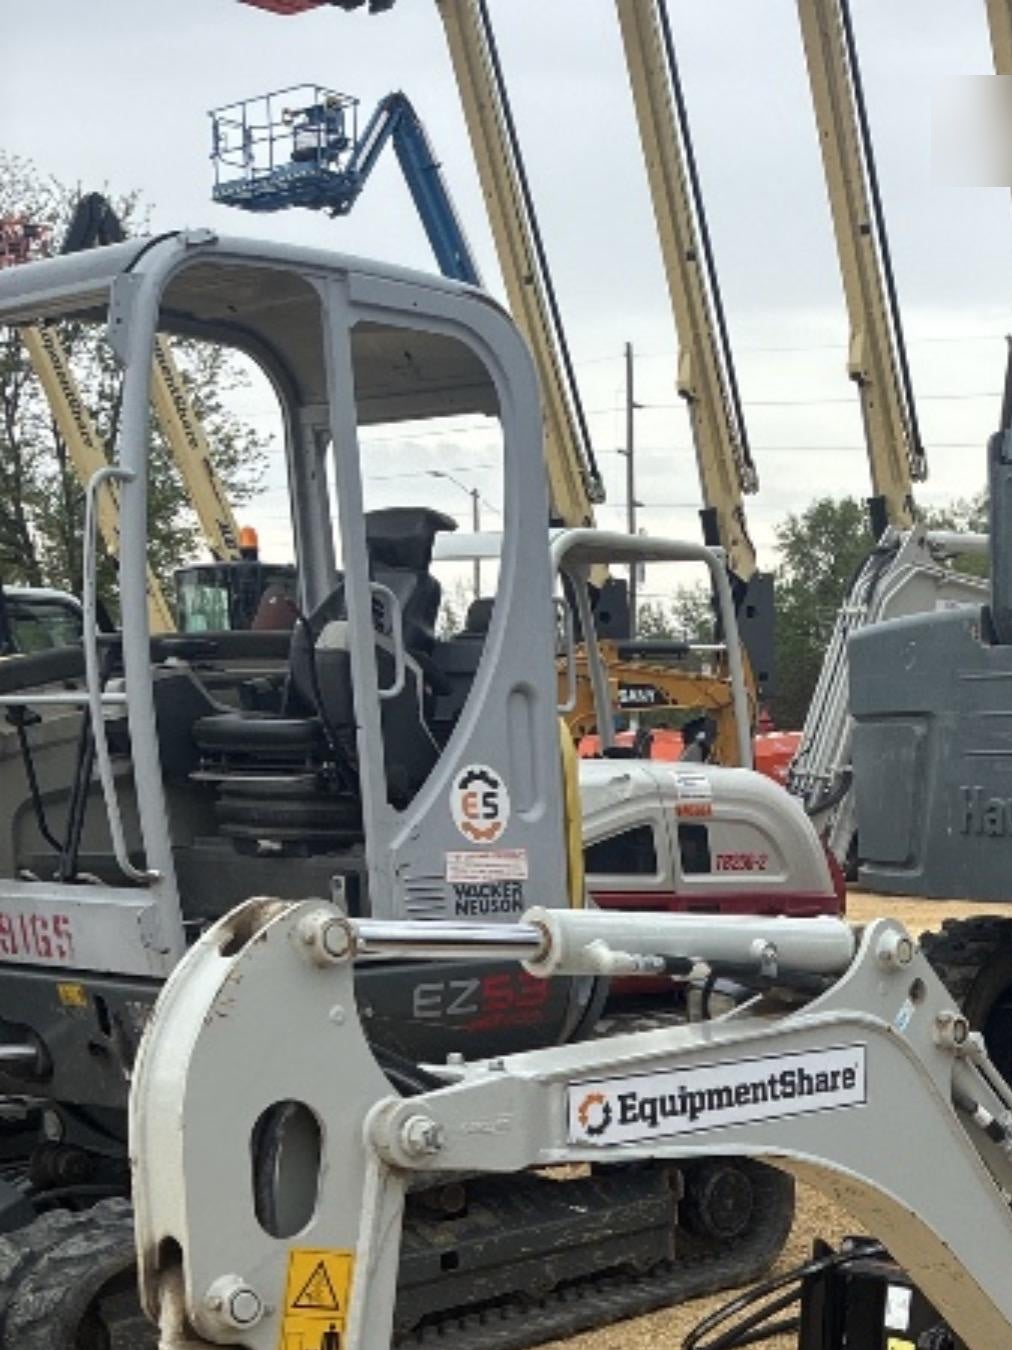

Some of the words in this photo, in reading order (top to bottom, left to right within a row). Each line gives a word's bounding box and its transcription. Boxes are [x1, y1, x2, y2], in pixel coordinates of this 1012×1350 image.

[461, 791, 499, 820] ES
[452, 880, 523, 900] WACKER
[455, 897, 525, 916] NEUSON
[616, 1066, 857, 1128] EquipmentShare
